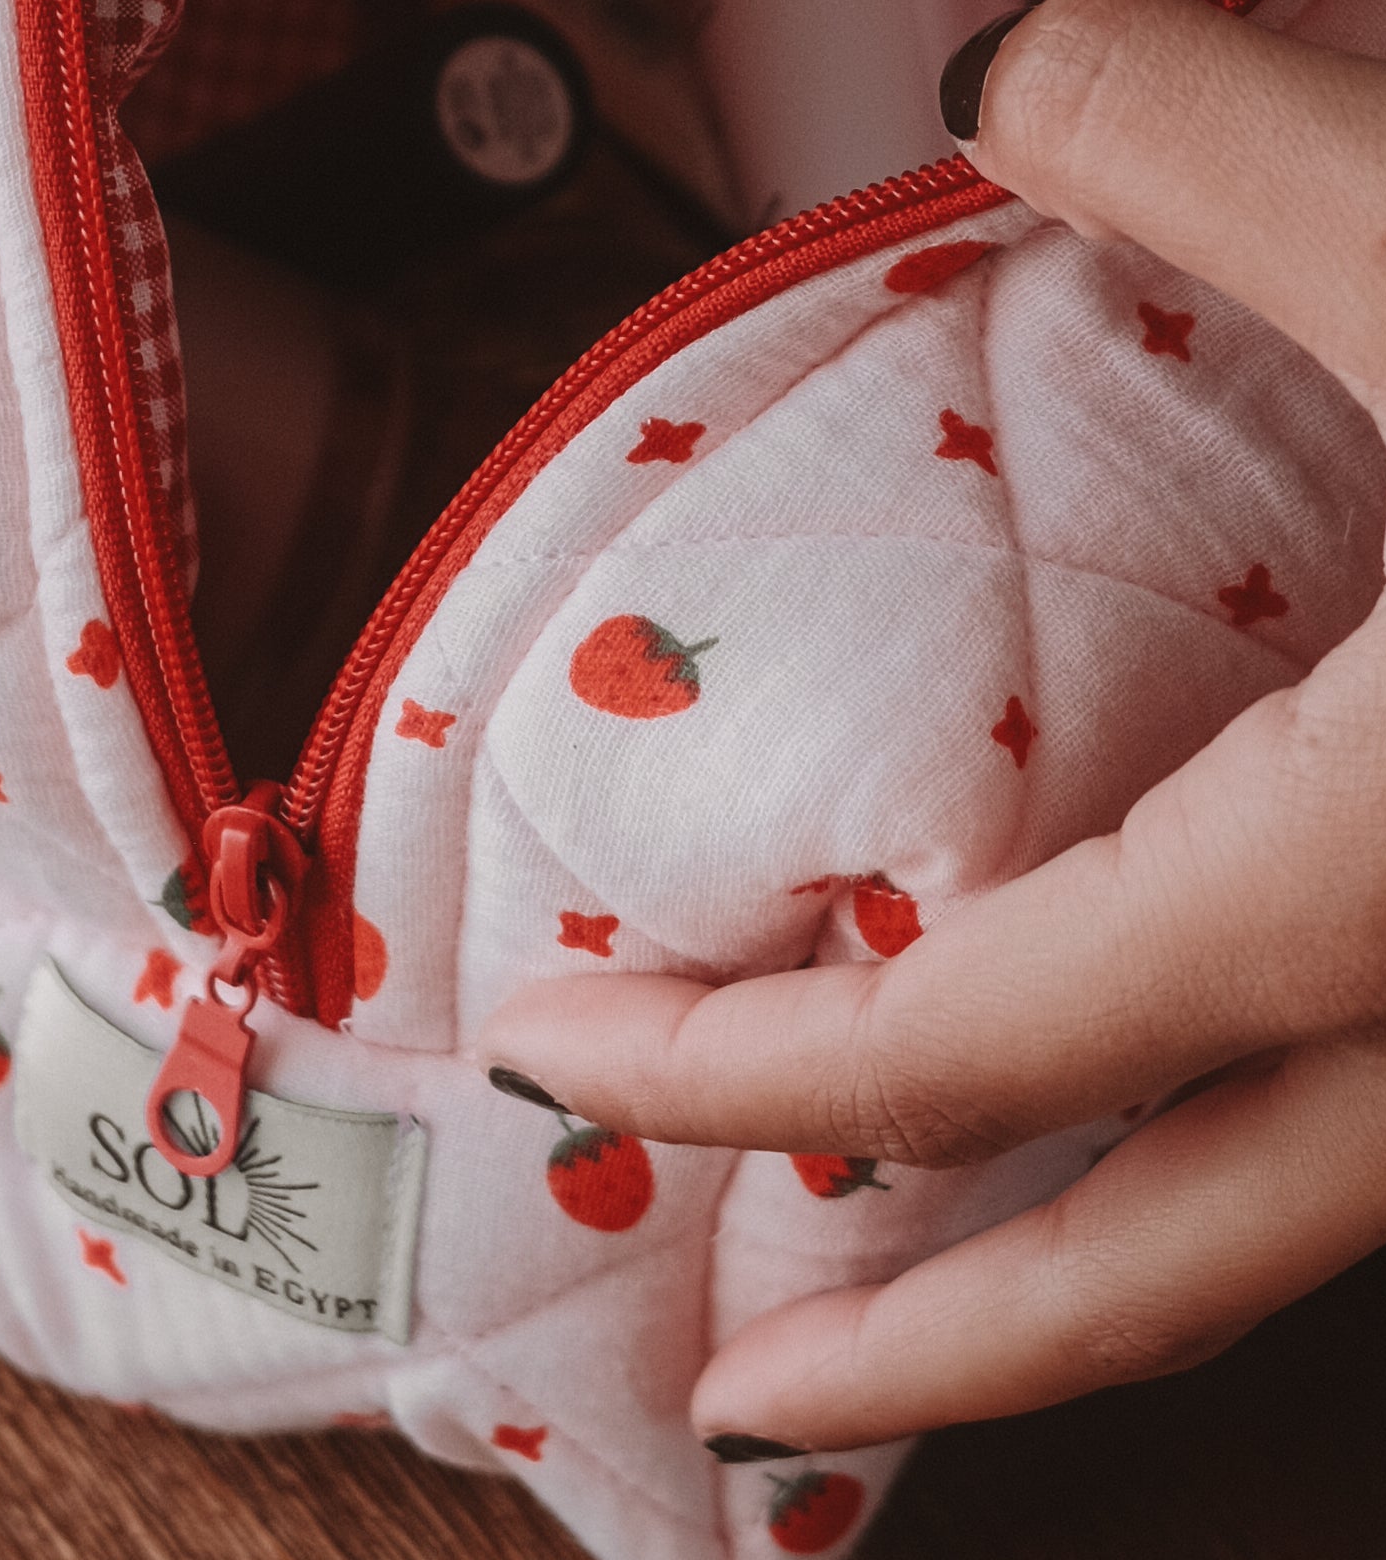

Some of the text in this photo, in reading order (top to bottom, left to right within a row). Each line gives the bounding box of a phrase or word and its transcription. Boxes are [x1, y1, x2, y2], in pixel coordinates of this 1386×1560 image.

[89, 1113, 248, 1241] SOL
[210, 1245, 241, 1278] in
[254, 1266, 378, 1320] EGYPT
